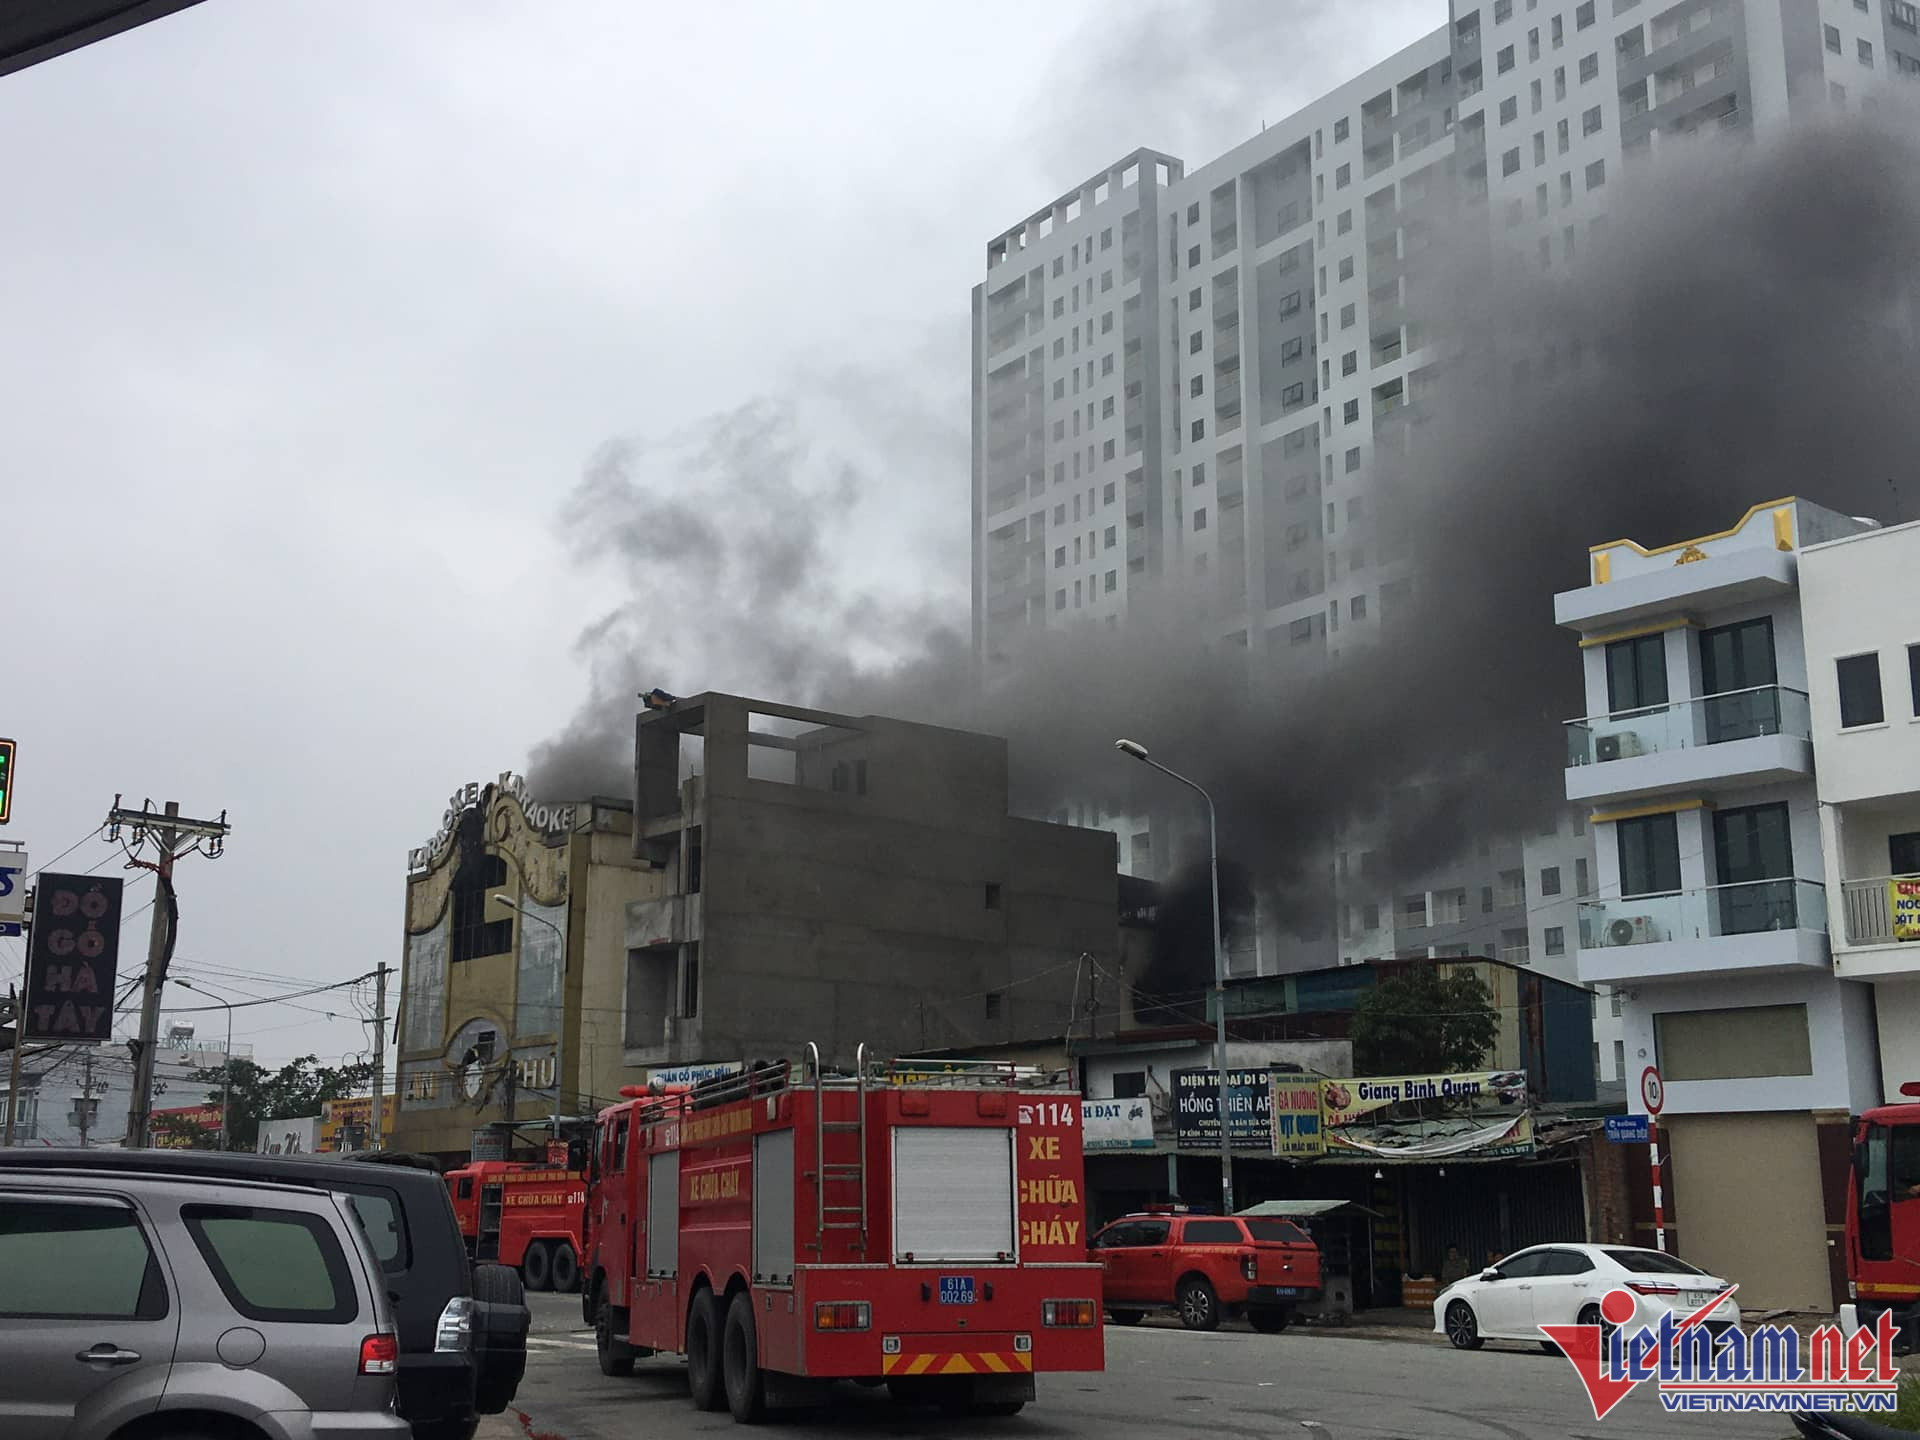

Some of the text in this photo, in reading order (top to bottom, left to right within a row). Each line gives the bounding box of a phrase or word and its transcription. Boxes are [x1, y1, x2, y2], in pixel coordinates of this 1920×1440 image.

[499, 771, 574, 832] KARAOKE
[1180, 1073, 1205, 1088] ĐIỆN
[1244, 1074, 1256, 1085] DI
[1359, 1082, 1400, 1103] Giang
[1036, 1103, 1074, 1126] 114
[1095, 1105, 1120, 1120] ĐẠT
[1029, 1137, 1061, 1160] XE
[506, 1194, 516, 1206] XE
[947, 1279, 967, 1290] 61A
